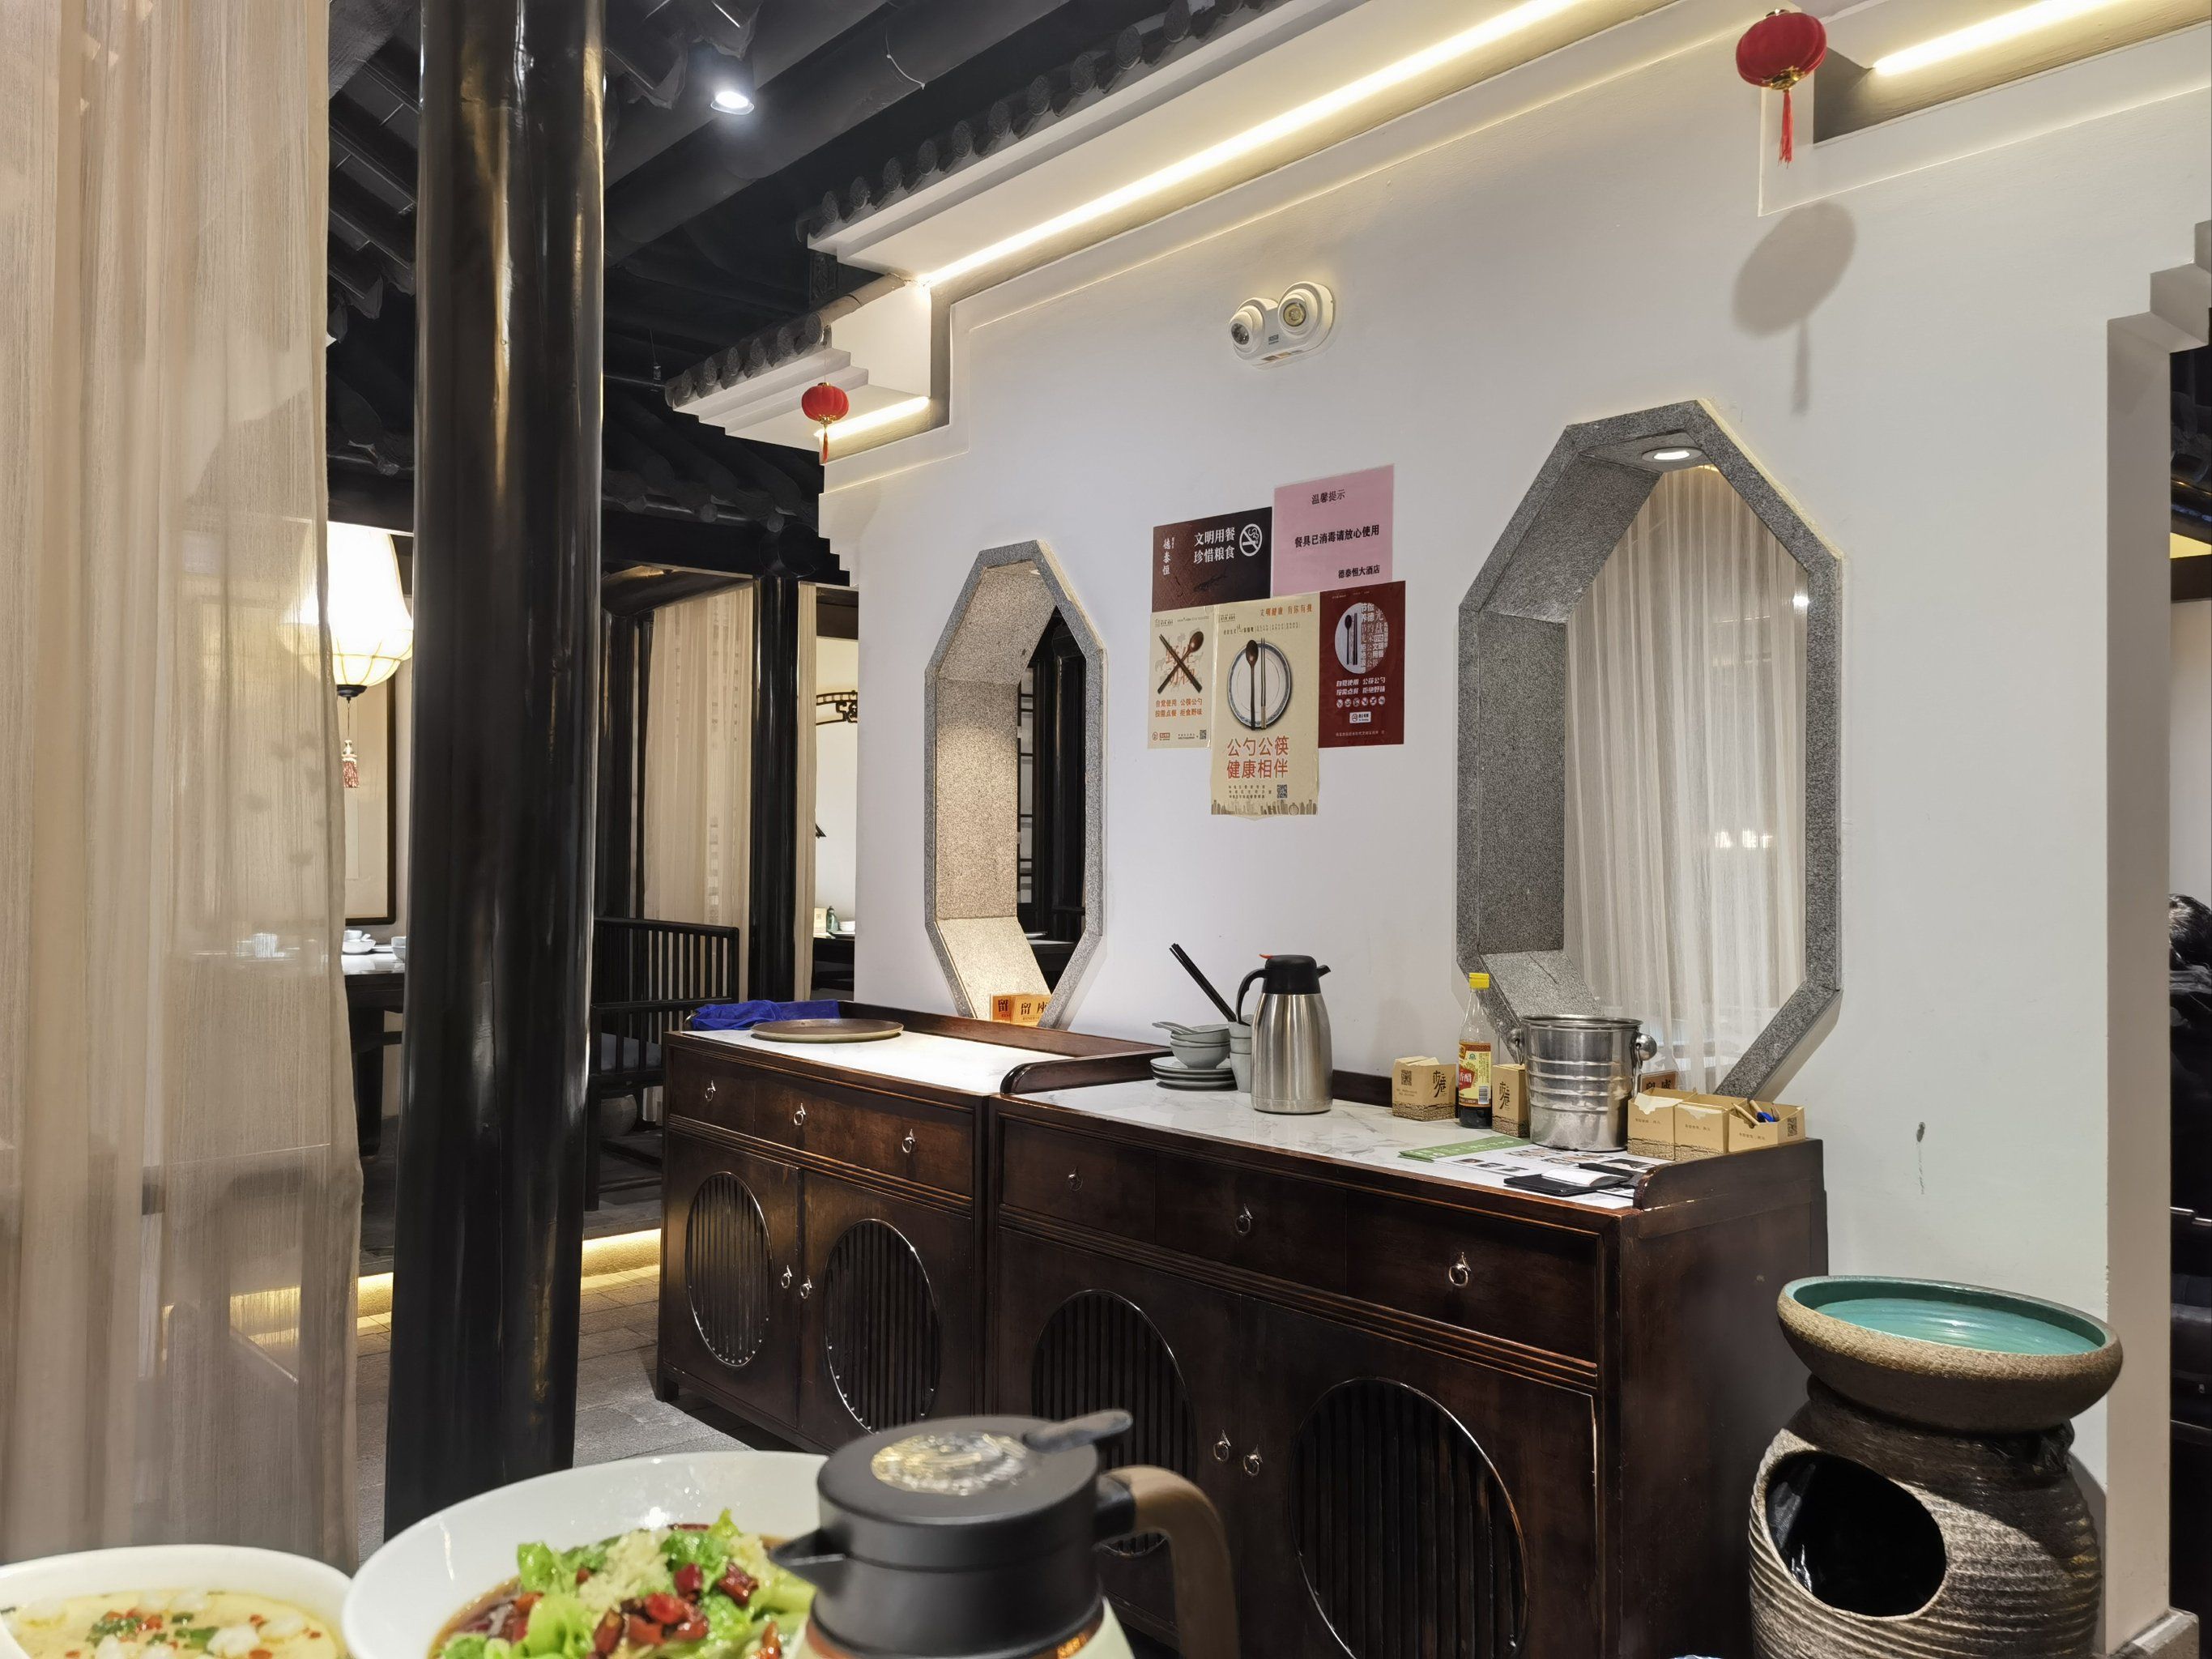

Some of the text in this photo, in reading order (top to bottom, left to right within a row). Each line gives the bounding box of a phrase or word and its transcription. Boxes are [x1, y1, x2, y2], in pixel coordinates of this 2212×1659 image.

[1311, 489, 1345, 505] 温馨提示
[1194, 527, 1235, 547] 文明用餐
[1294, 524, 1379, 548] 餐具已消毒请放心使用
[1193, 545, 1235, 564] 珍惜粮食
[1338, 565, 1380, 578] 德泰恒大酒店
[1362, 676, 1386, 684] 公筷公勺
[1156, 698, 1203, 707] 自觉使用 公筷公勺
[1155, 708, 1203, 718] 按需点餐 拒食野味
[1227, 736, 1289, 757] 公勺公筷
[1227, 758, 1288, 778] 健康相伴
